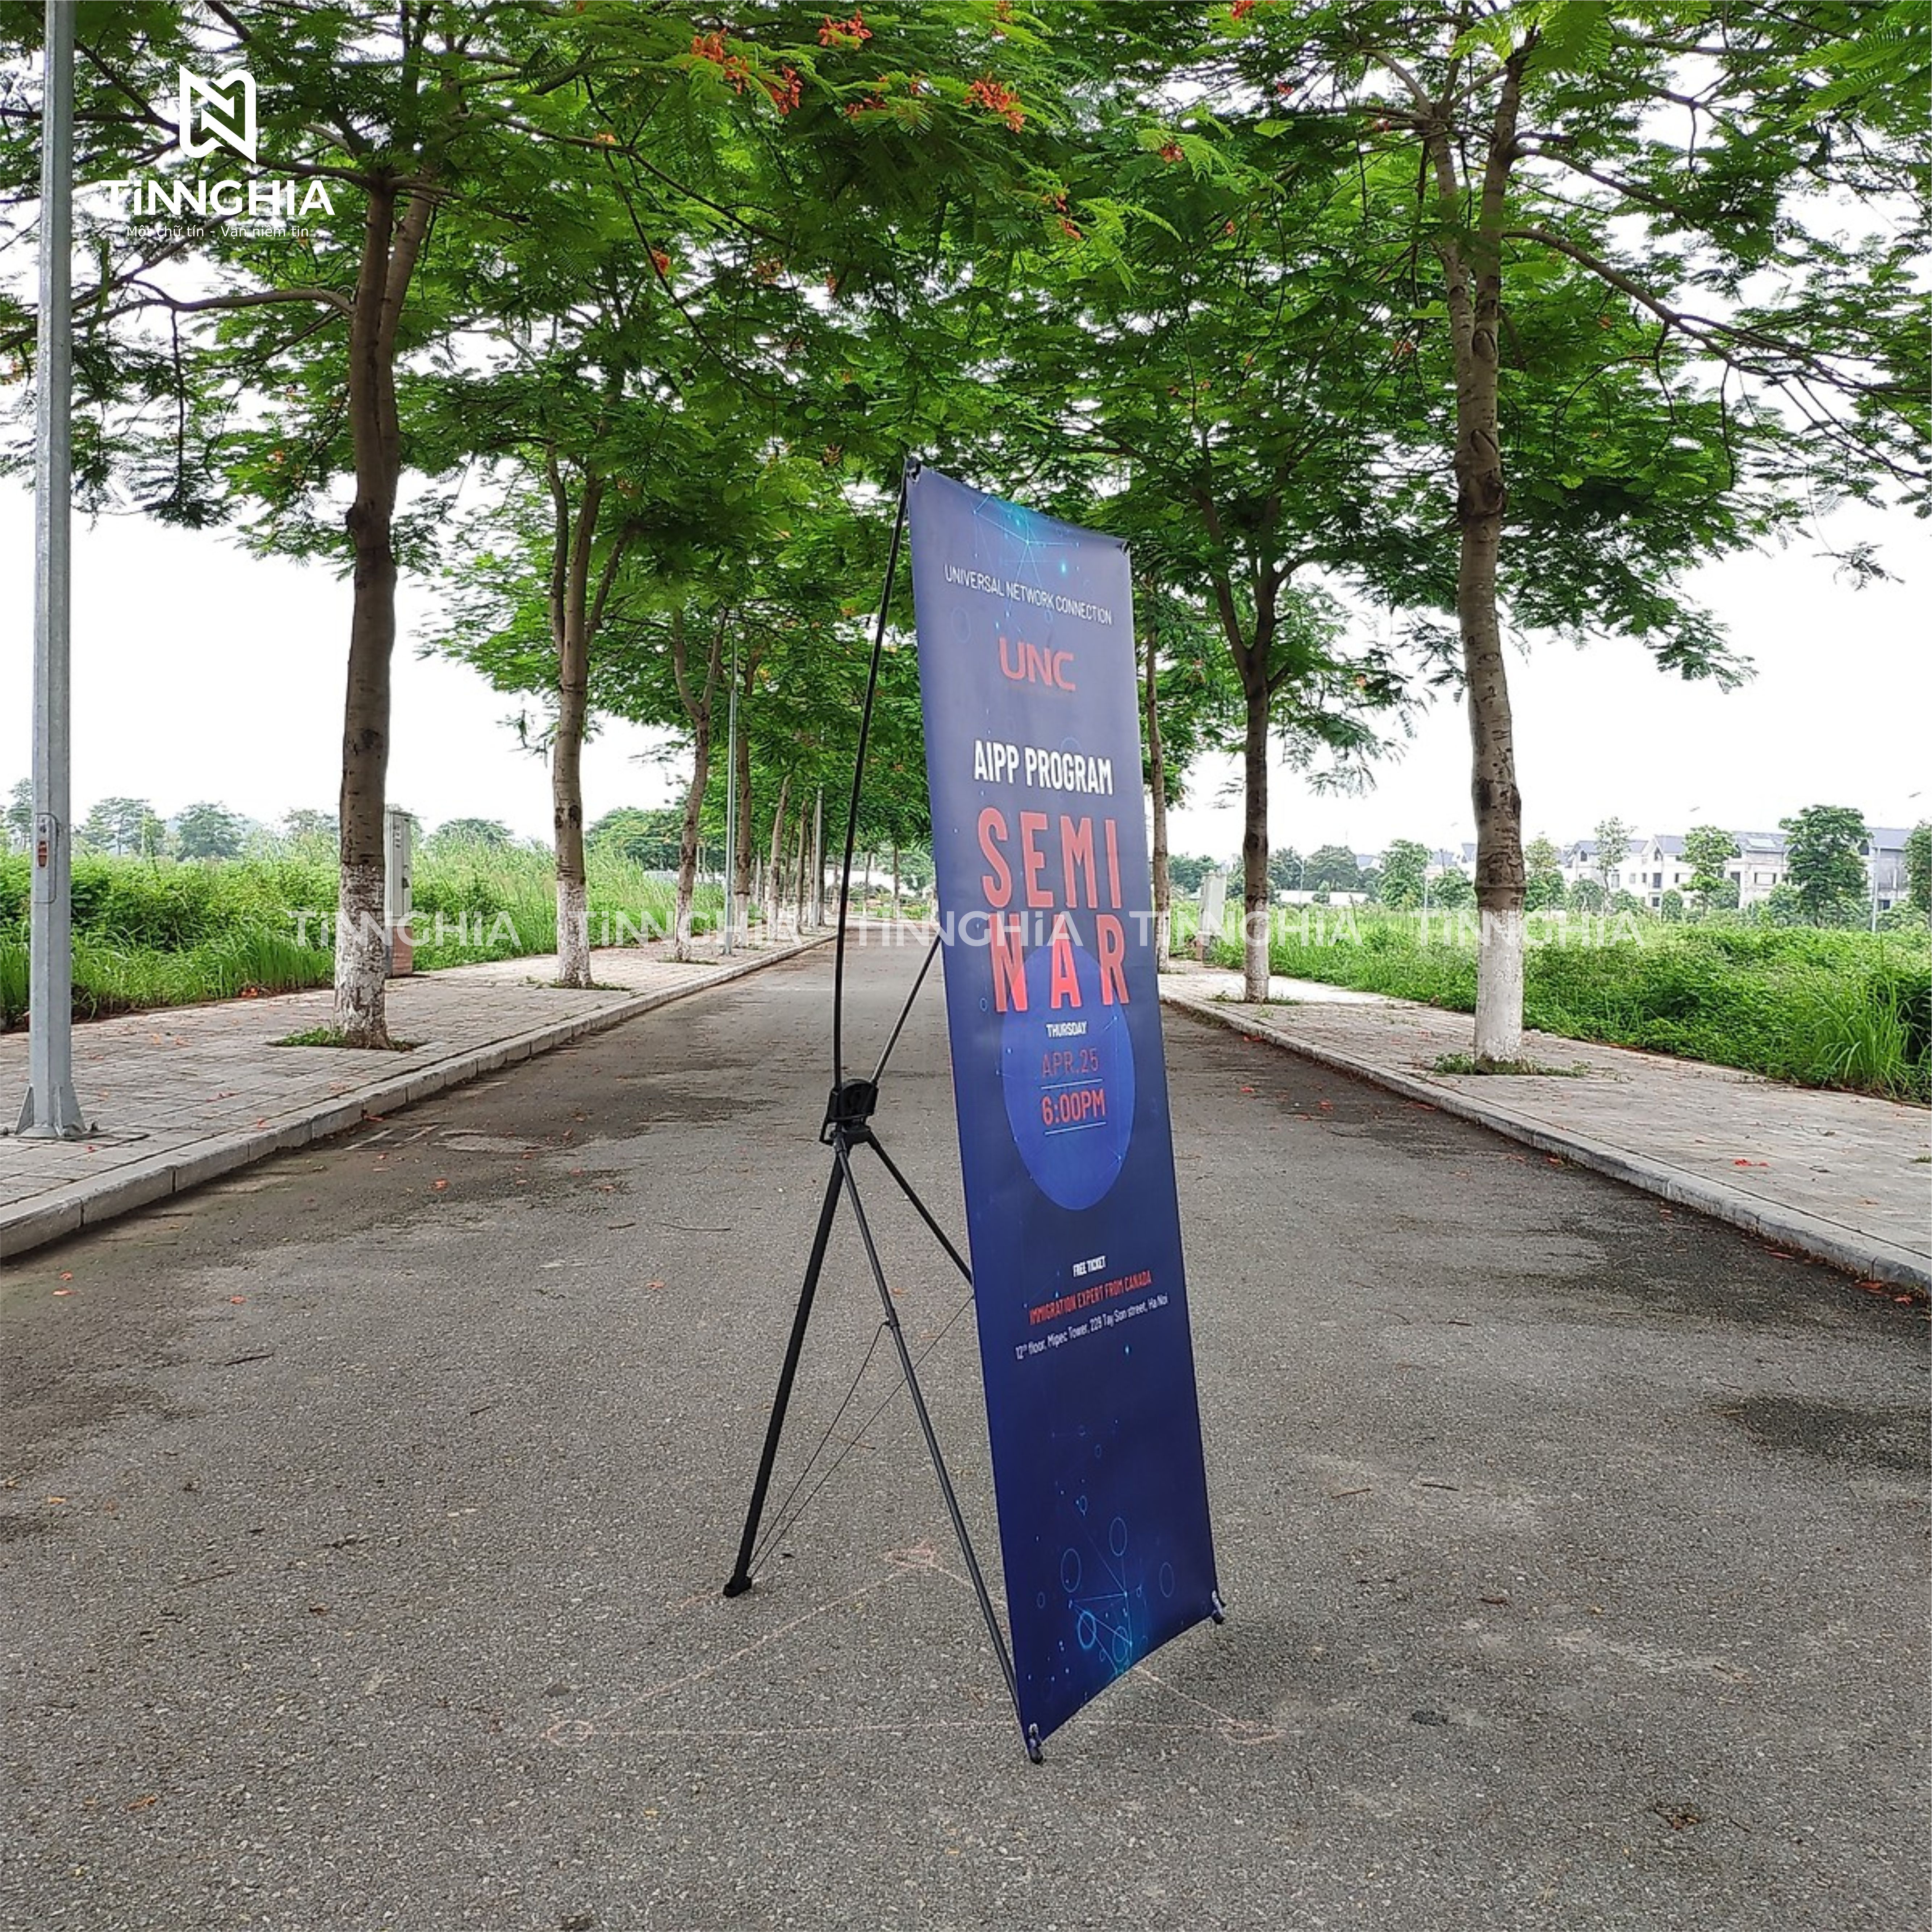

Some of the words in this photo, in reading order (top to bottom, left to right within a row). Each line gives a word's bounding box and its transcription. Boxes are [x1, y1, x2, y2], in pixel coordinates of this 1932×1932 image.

[944, 565, 1005, 597] UNIVERSAL
[1005, 581, 1055, 609] NETWORK
[1055, 596, 1112, 625] CONNECTION
[999, 637, 1076, 691] UNC
[974, 740, 1019, 783] AIPP
[1024, 747, 1114, 795] PROGRAM
[977, 807, 1122, 909] SEMI
[989, 913, 1130, 1012] NAR
[1046, 1021, 1087, 1037] THURSDAY
[1042, 1047, 1099, 1078] APR.25
[1042, 1088, 1105, 1126] 6:00PM
[1073, 1261, 1087, 1277] FREE
[1087, 1255, 1106, 1272] TICKET
[1029, 1293, 1076, 1326] IMMIGRATION
[1077, 1284, 1103, 1308] EXPERT
[1105, 1279, 1124, 1299] FROM
[1124, 1270, 1152, 1292] CANADA
